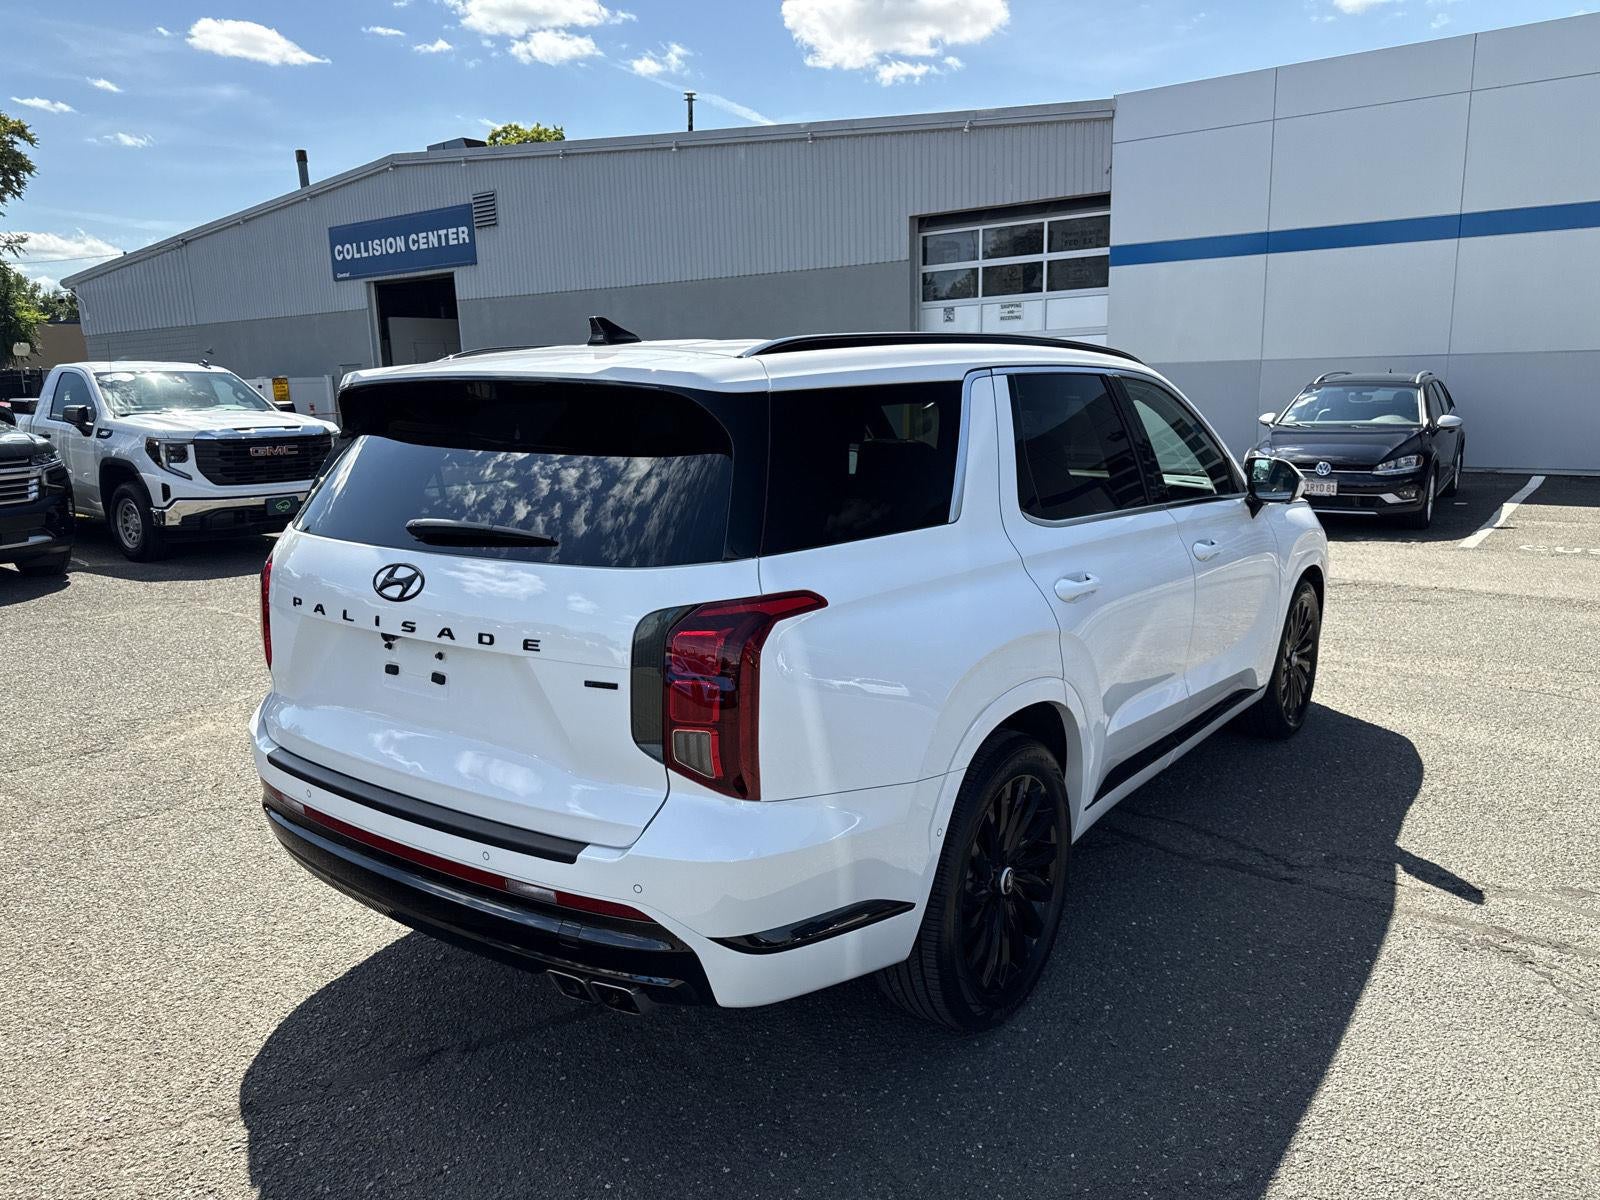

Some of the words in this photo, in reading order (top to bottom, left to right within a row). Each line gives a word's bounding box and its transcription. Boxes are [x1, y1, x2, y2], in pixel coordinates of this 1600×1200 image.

[335, 236, 405, 261] COLLISION
[409, 226, 469, 251] CENTER
[250, 445, 299, 456] GMC
[292, 596, 541, 652] PALISADE
